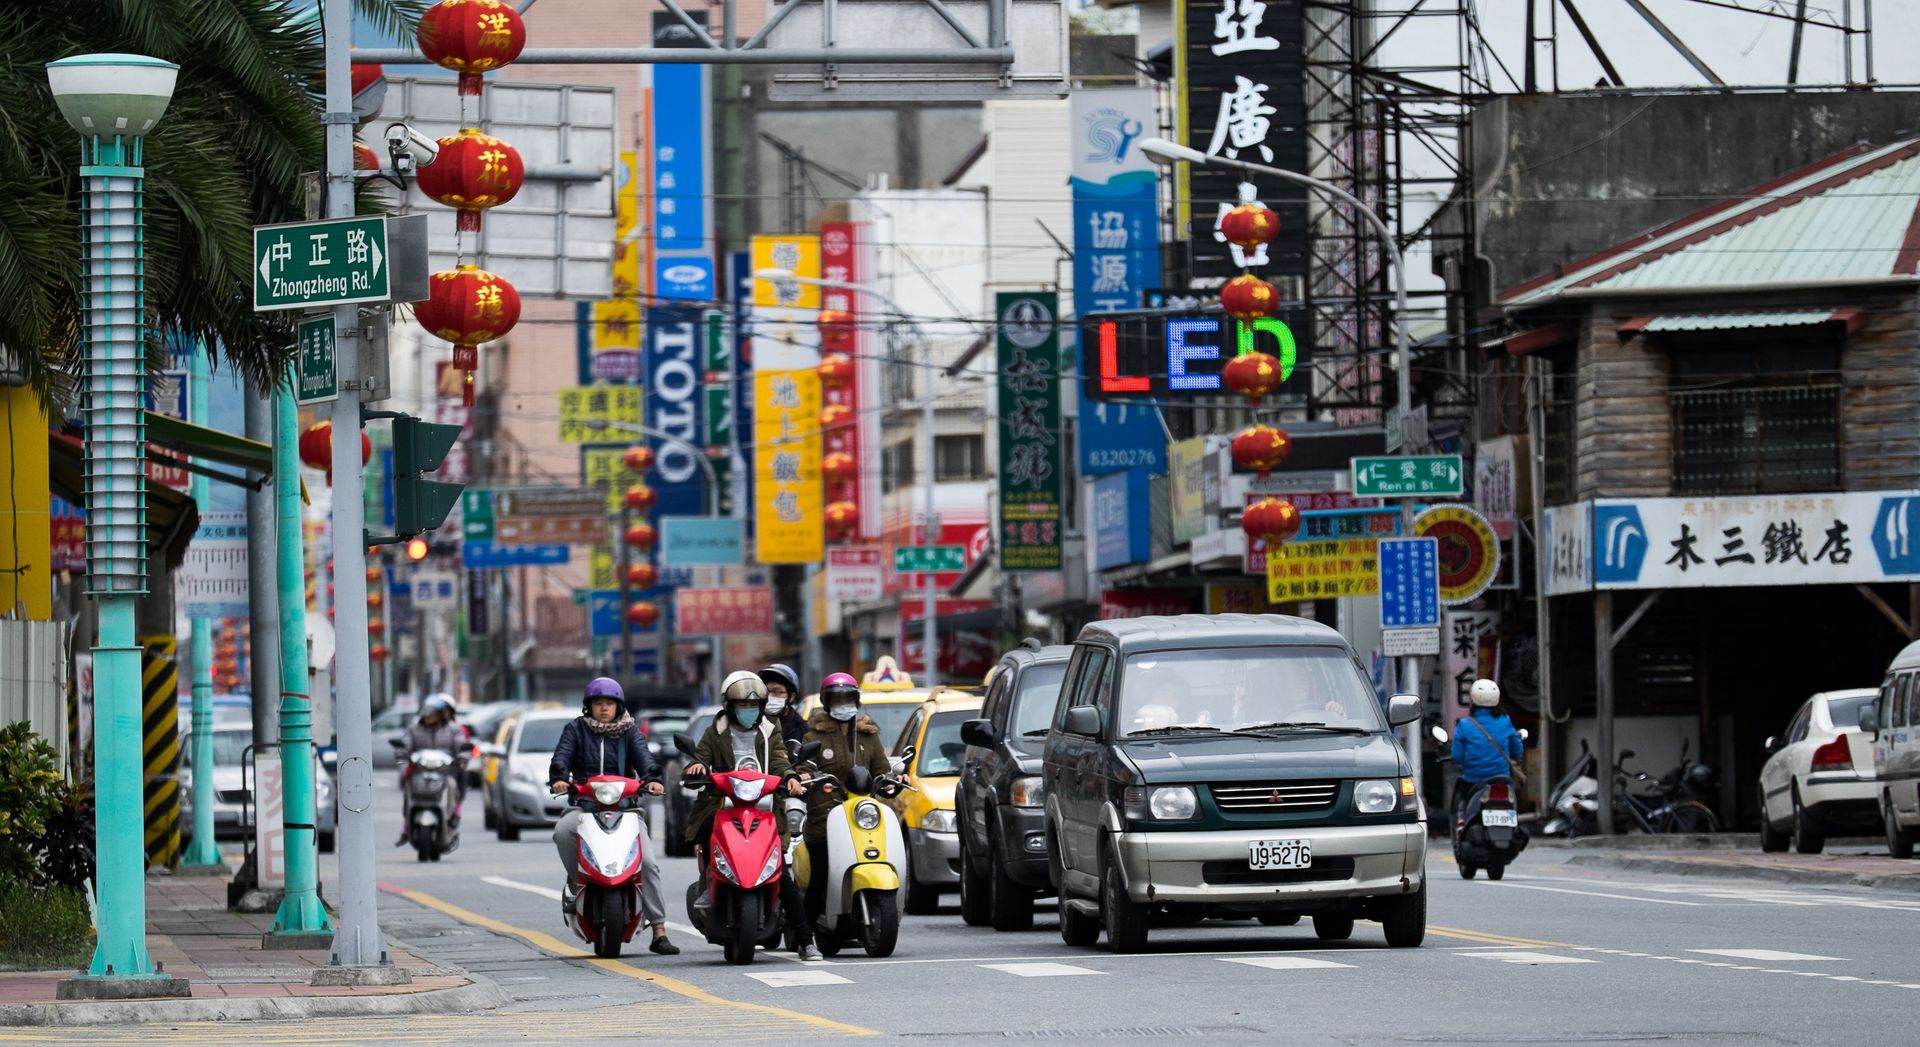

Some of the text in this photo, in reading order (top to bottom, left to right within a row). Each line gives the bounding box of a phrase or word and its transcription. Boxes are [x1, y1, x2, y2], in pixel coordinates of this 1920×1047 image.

[477, 150, 511, 190] 花
[272, 228, 369, 272] 中正路
[272, 270, 371, 300] Zhongzheng Rd.
[303, 326, 331, 367] 中華路
[1099, 317, 1297, 391] LED
[654, 321, 697, 484] TOTO
[769, 375, 803, 522] 池上飯包
[1090, 448, 1157, 468] 8320276
[1369, 461, 1447, 480] 仁愛街
[1665, 517, 1853, 573] 木三鐵店
